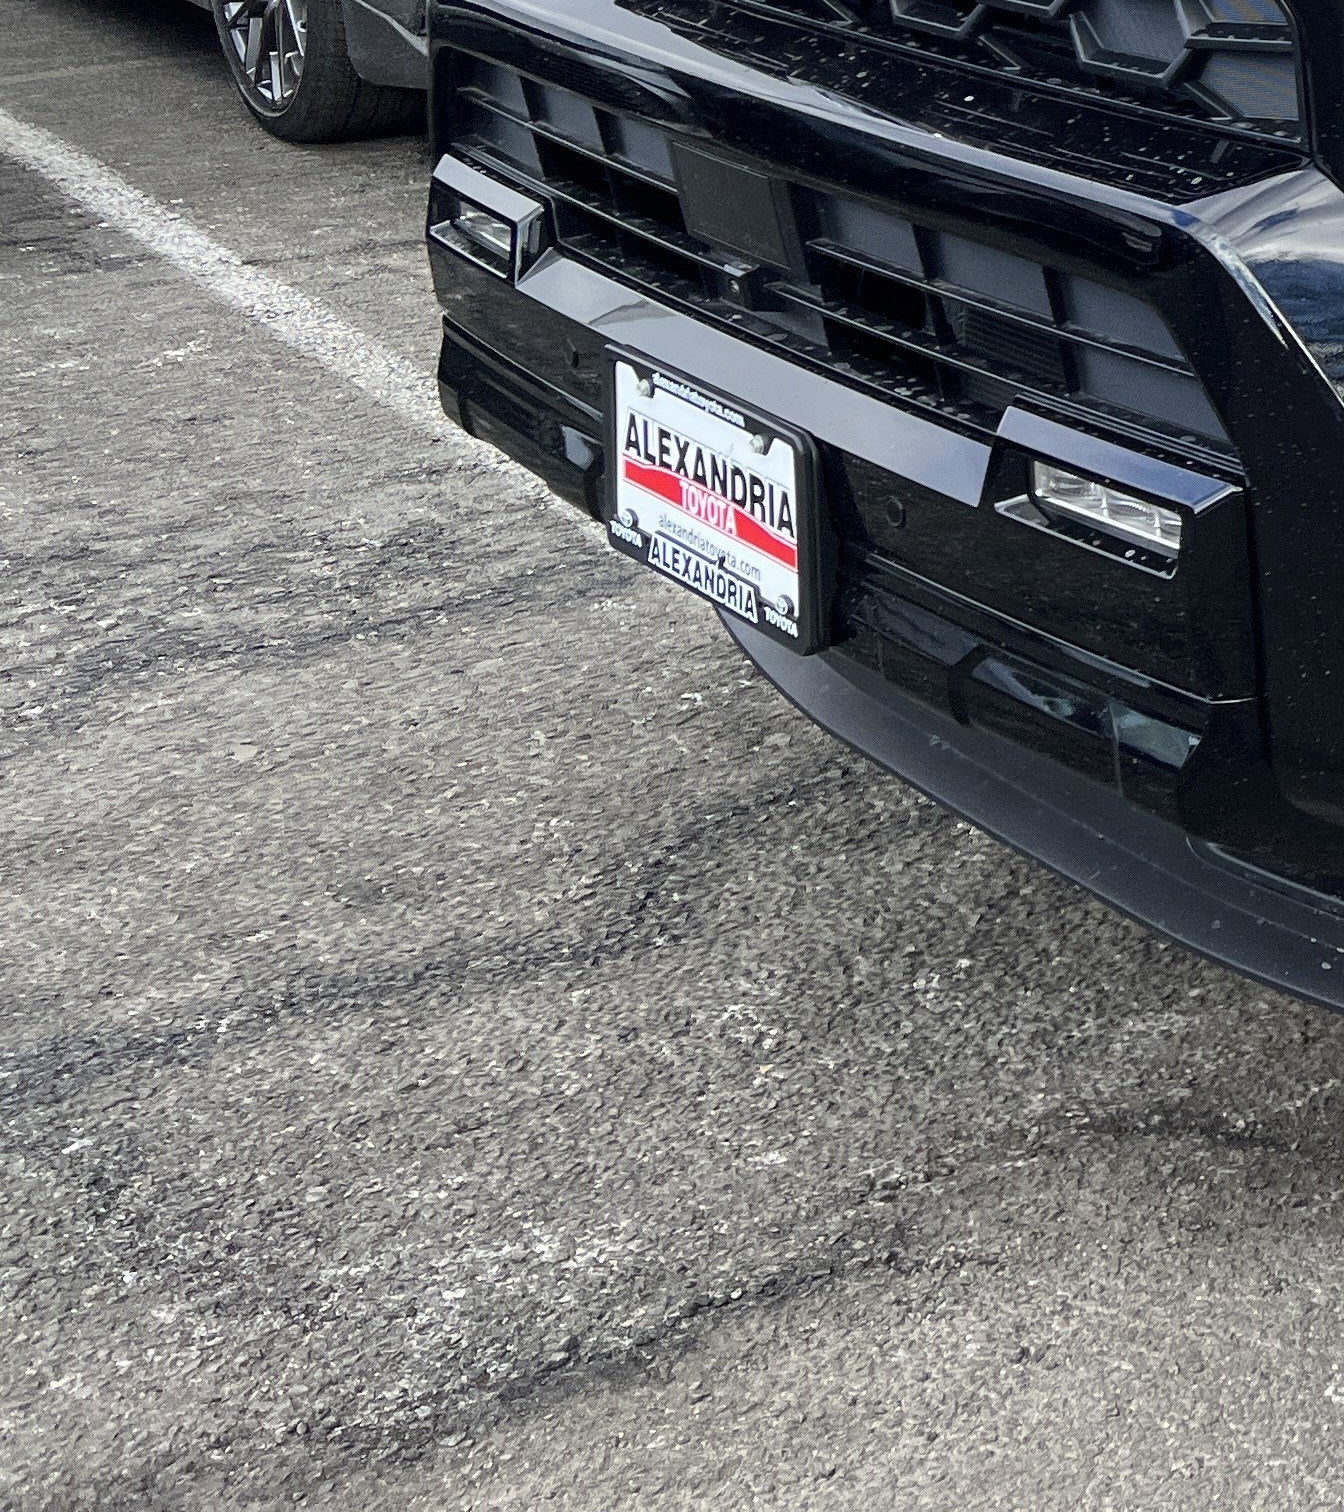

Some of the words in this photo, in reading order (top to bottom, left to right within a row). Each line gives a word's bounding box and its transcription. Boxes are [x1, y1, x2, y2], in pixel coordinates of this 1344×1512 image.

[624, 411, 795, 538] ALEXANDRIA
[609, 520, 643, 548] TOYOTA
[678, 480, 738, 536] TOYOTA
[650, 536, 757, 621] ALEXANDRIA
[659, 513, 761, 582] alexandriatoyota.com
[764, 606, 799, 638] TOYOTA
